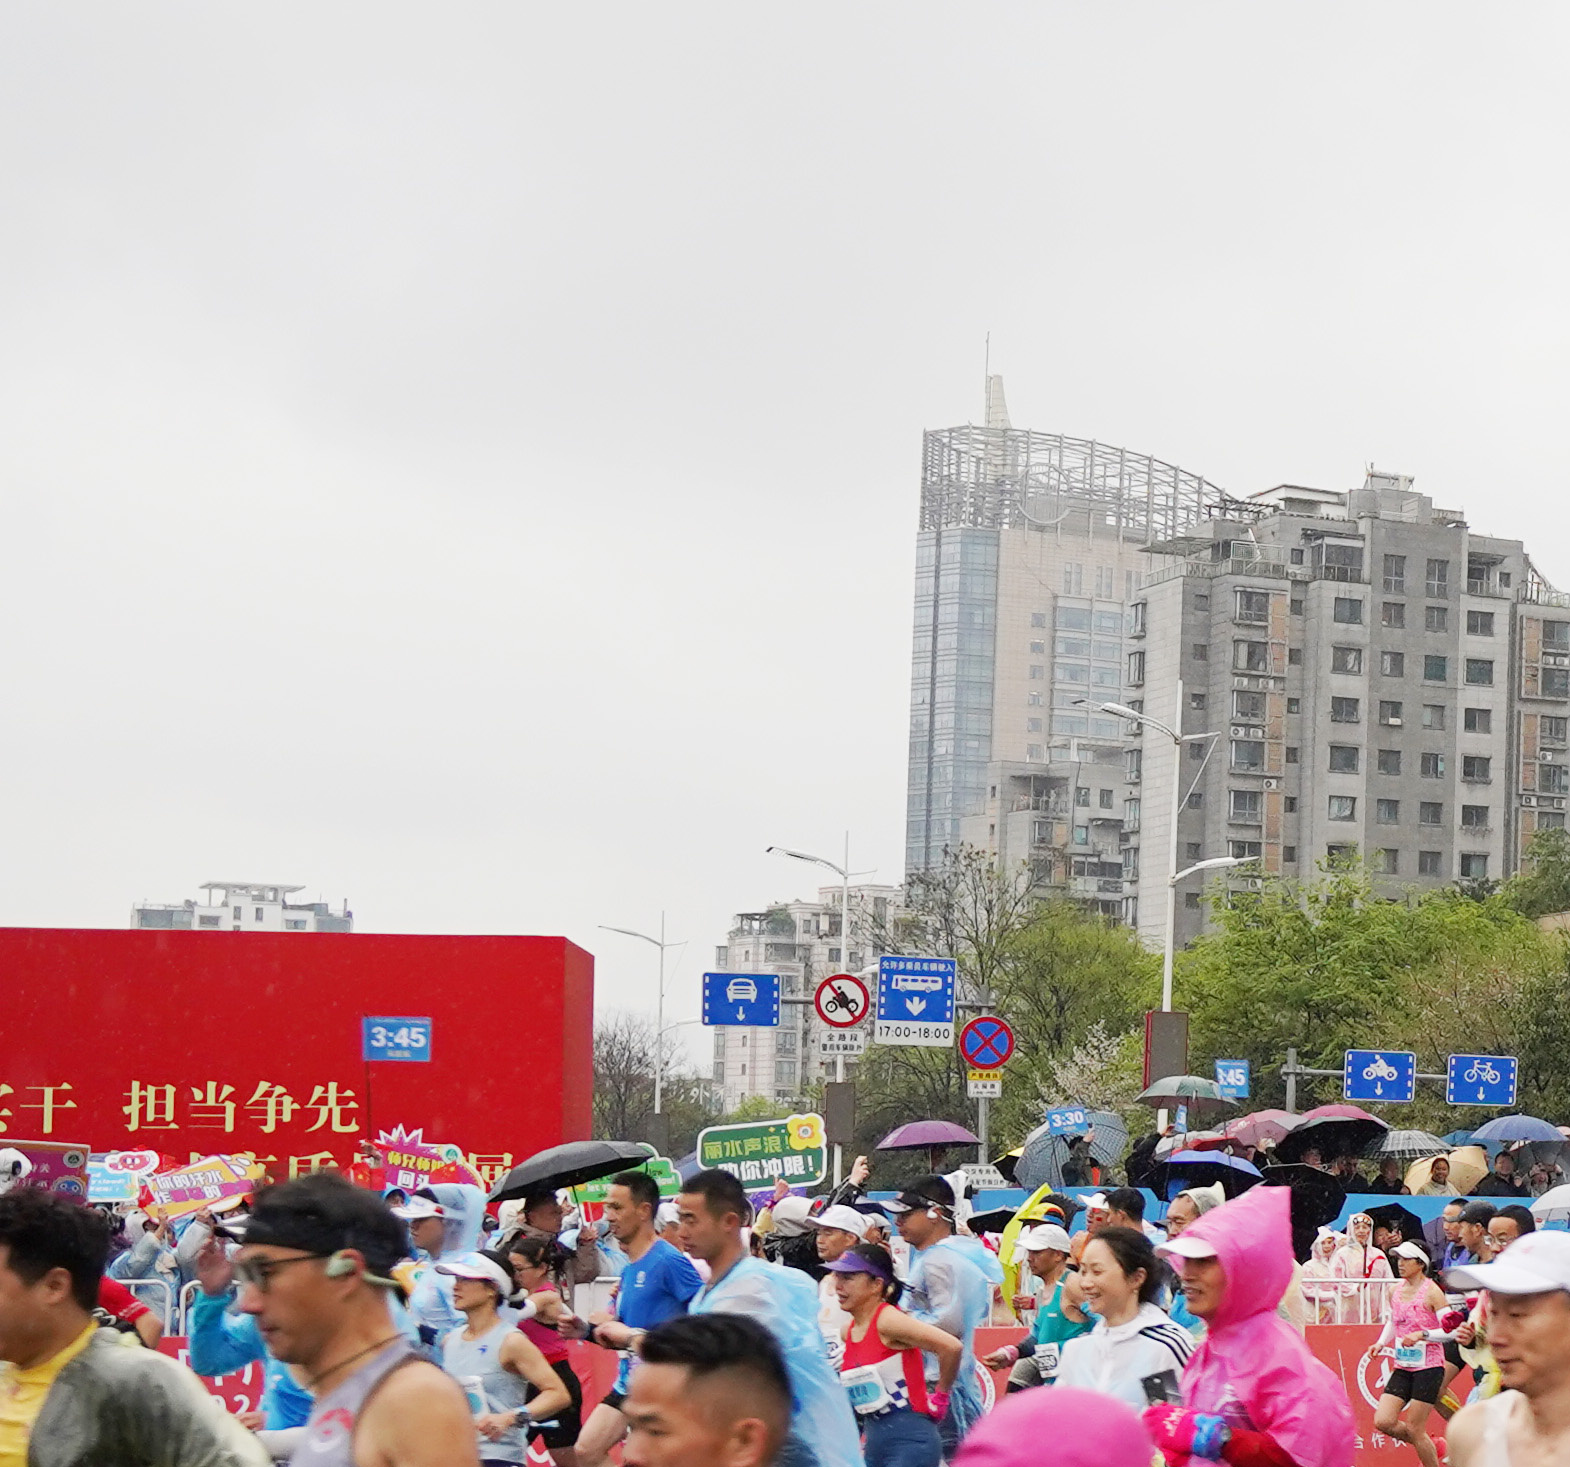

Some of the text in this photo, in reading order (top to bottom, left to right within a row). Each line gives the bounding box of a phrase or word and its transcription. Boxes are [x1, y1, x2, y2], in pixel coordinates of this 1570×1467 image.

[370, 1026, 427, 1049] 3:45
[879, 1025, 950, 1039] 17:00-18:00
[121, 1079, 362, 1134] 担当争先
[1050, 1111, 1084, 1127] 3:30
